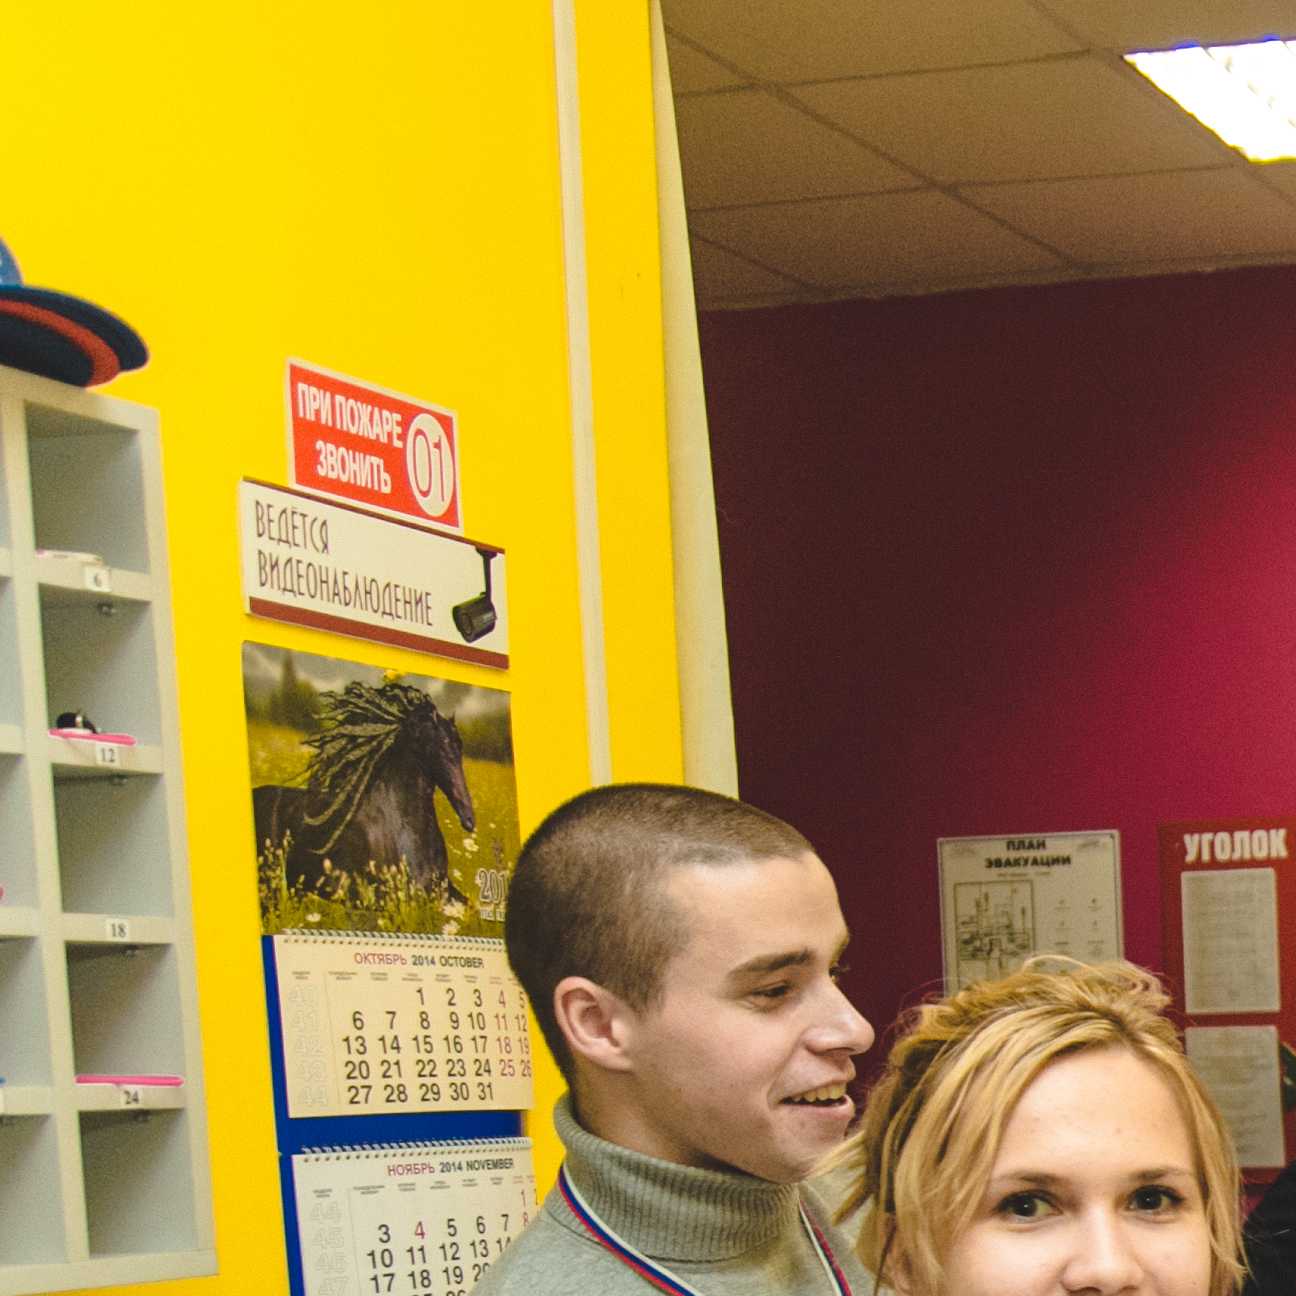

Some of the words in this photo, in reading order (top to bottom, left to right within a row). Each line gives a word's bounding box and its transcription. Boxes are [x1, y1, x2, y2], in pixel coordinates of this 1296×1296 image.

[297, 382, 332, 426] ПРИ
[334, 394, 404, 448] ПОЖАРЕ
[315, 440, 392, 494] ЗВОНИТЬ
[412, 426, 447, 503] 01
[255, 499, 330, 554] ВЕДЁТСЯ
[258, 549, 433, 626] ВИДЕОНАБЛЮДЕНИЕ
[101, 748, 115, 763] 12
[1006, 839, 1047, 851] ПЛАН
[1183, 828, 1289, 864] УГОЛОК
[984, 854, 1071, 869] ЭВАКУАЦИИ
[110, 922, 127, 939] 18
[354, 953, 407, 965] ОКТЯБРЬ
[411, 955, 436, 966] 2014
[439, 956, 484, 969] OCTOBER
[416, 988, 425, 1005] 1
[446, 988, 456, 1006] 2
[473, 989, 483, 1007] 3
[498, 990, 506, 1008] 4
[519, 992, 525, 1008] 5
[353, 1011, 364, 1030] 6
[386, 1011, 396, 1029] 7
[419, 1011, 430, 1029] 8
[450, 1012, 459, 1029] 9
[468, 1012, 486, 1030] 10
[495, 1013, 508, 1031] 11
[515, 1013, 527, 1032] 12
[342, 1035, 367, 1055] 13
[378, 1035, 401, 1054] 14
[412, 1035, 433, 1054] 15
[443, 1035, 463, 1054] 16
[471, 1036, 488, 1054] 17
[496, 1036, 512, 1054] 18
[518, 1037, 530, 1055] 19
[344, 1060, 370, 1079] 20
[380, 1060, 402, 1078] 21
[416, 1059, 437, 1078] 22
[446, 1059, 466, 1077] 23
[474, 1059, 491, 1077] 24
[499, 1059, 515, 1077] 25
[520, 1059, 532, 1078] 26
[123, 1090, 140, 1104] 24
[348, 1085, 372, 1105] 27
[383, 1084, 408, 1103] 28
[419, 1084, 441, 1102] 29
[450, 1083, 469, 1101] 30
[477, 1082, 494, 1100] 31
[387, 1163, 435, 1177] НОЯБРЬ
[440, 1161, 463, 1173] 2014
[466, 1158, 515, 1170] NOVEMBER
[520, 1189, 527, 1207] 1
[378, 1224, 391, 1244] 3
[414, 1221, 425, 1240] 4
[447, 1219, 457, 1237] 5
[476, 1216, 486, 1235] 6
[501, 1214, 510, 1232] 7
[367, 1249, 393, 1270] 10
[406, 1245, 427, 1265] 11
[439, 1242, 460, 1261] 12
[469, 1239, 489, 1258] 13
[370, 1273, 396, 1293] 17
[407, 1270, 432, 1289] 18
[443, 1267, 463, 1285] 19
